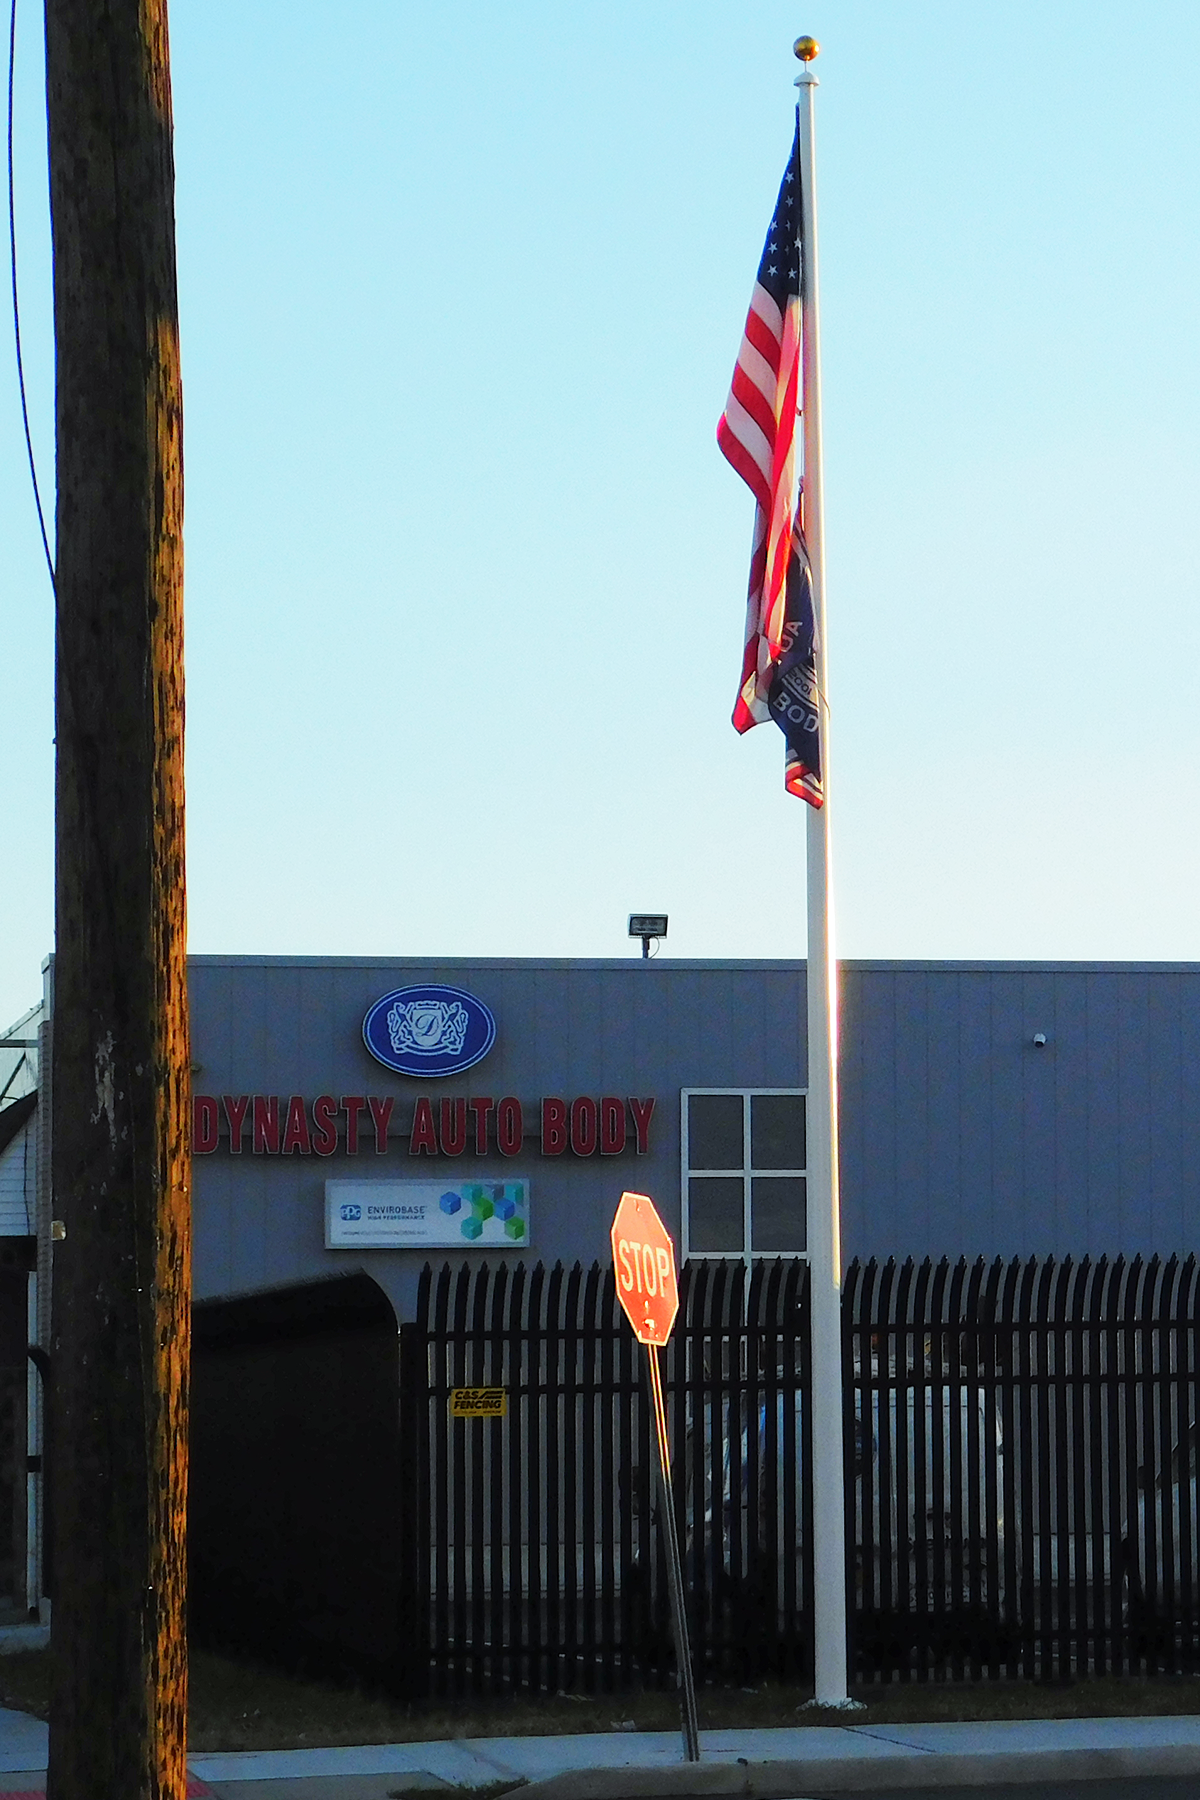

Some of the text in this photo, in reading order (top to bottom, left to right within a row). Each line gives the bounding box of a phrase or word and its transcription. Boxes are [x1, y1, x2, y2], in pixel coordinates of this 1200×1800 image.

[773, 691, 818, 733] BOD
[193, 1094, 655, 1157] DYNASTY AUTO BODY
[341, 1205, 426, 1220] PPG ENVIROBASE
[618, 1238, 670, 1298] STOP
[454, 1400, 502, 1410] FENCING
[455, 1390, 479, 1400] C&S
